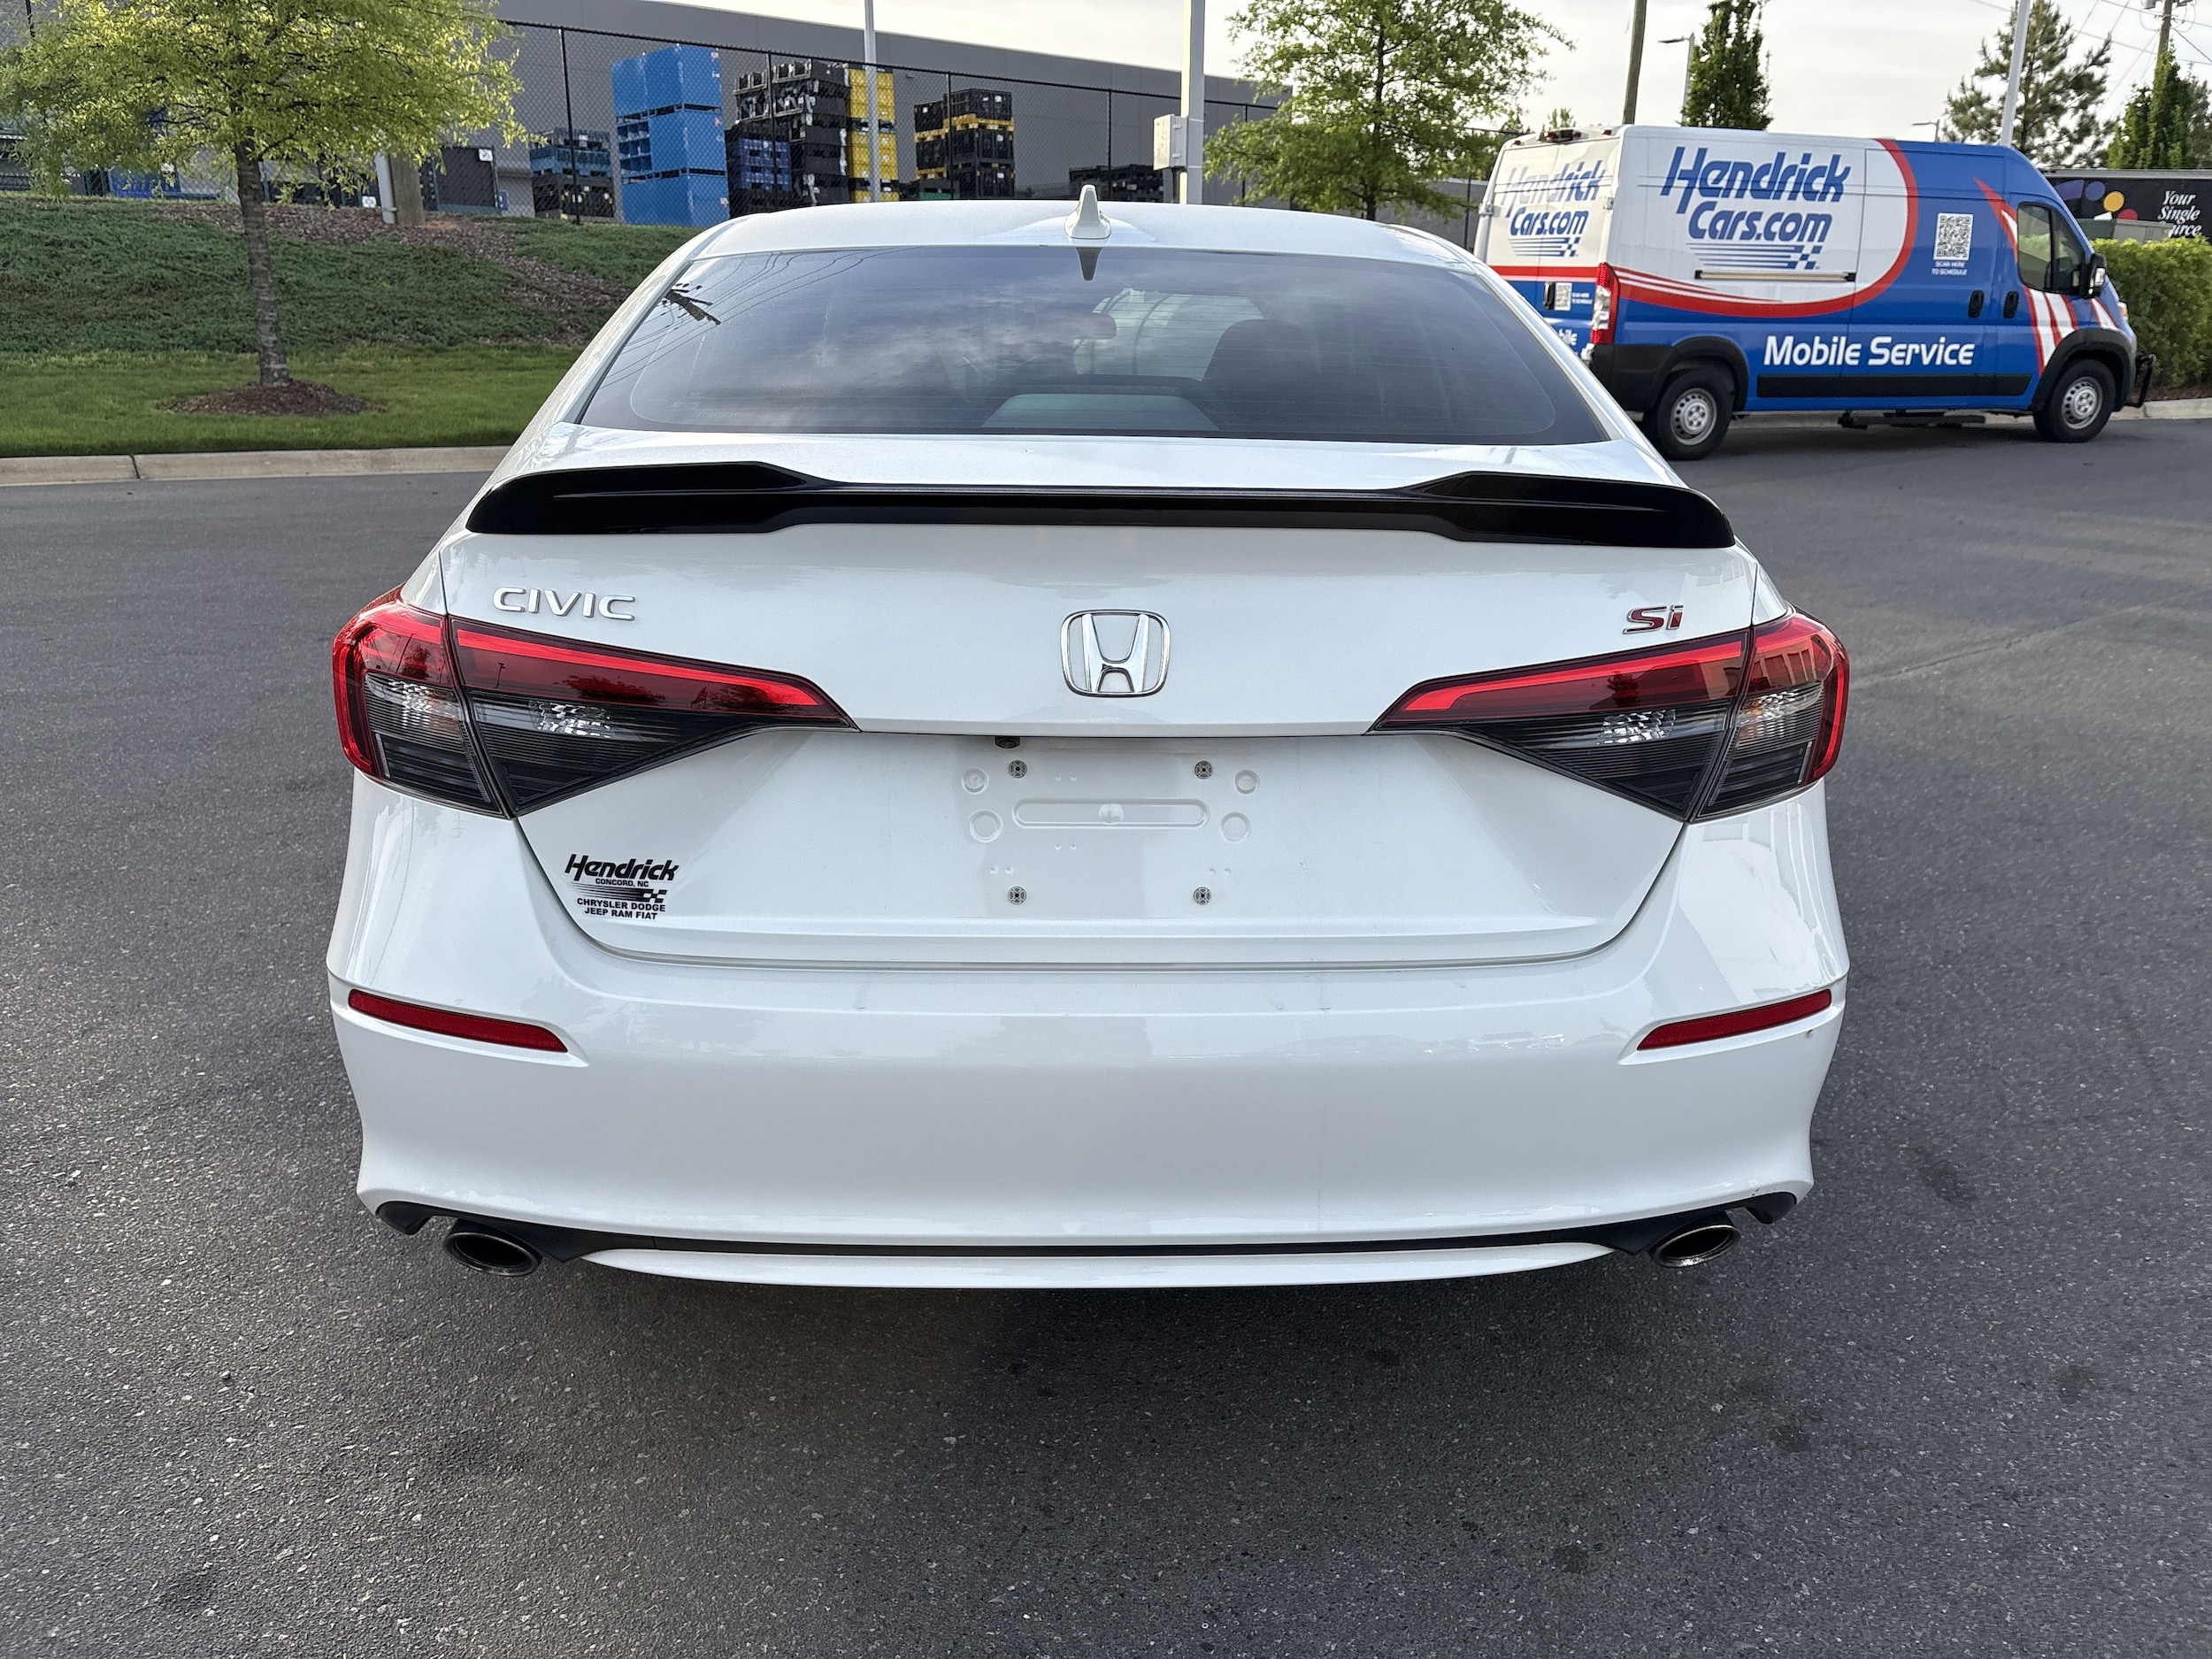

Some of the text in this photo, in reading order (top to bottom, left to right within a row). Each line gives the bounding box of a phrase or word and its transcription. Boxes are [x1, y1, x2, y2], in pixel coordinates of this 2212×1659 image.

[1501, 160, 1606, 218] Hendrick
[1660, 146, 1852, 214] Hendrick
[2162, 190, 2196, 205] Your
[1510, 206, 1589, 235] Cars.com
[1688, 201, 1833, 242] Cars.com
[2157, 205, 2201, 225] Single
[1763, 335, 1975, 366] Mobile Service
[493, 587, 636, 621] CIVIC
[1622, 604, 1685, 635] Si
[565, 854, 680, 881] Hendrick
[595, 878, 635, 887] CONCORD,
[577, 897, 665, 912] CHRYSLER DODGE
[585, 907, 657, 920] JEEP RAM FIAT
